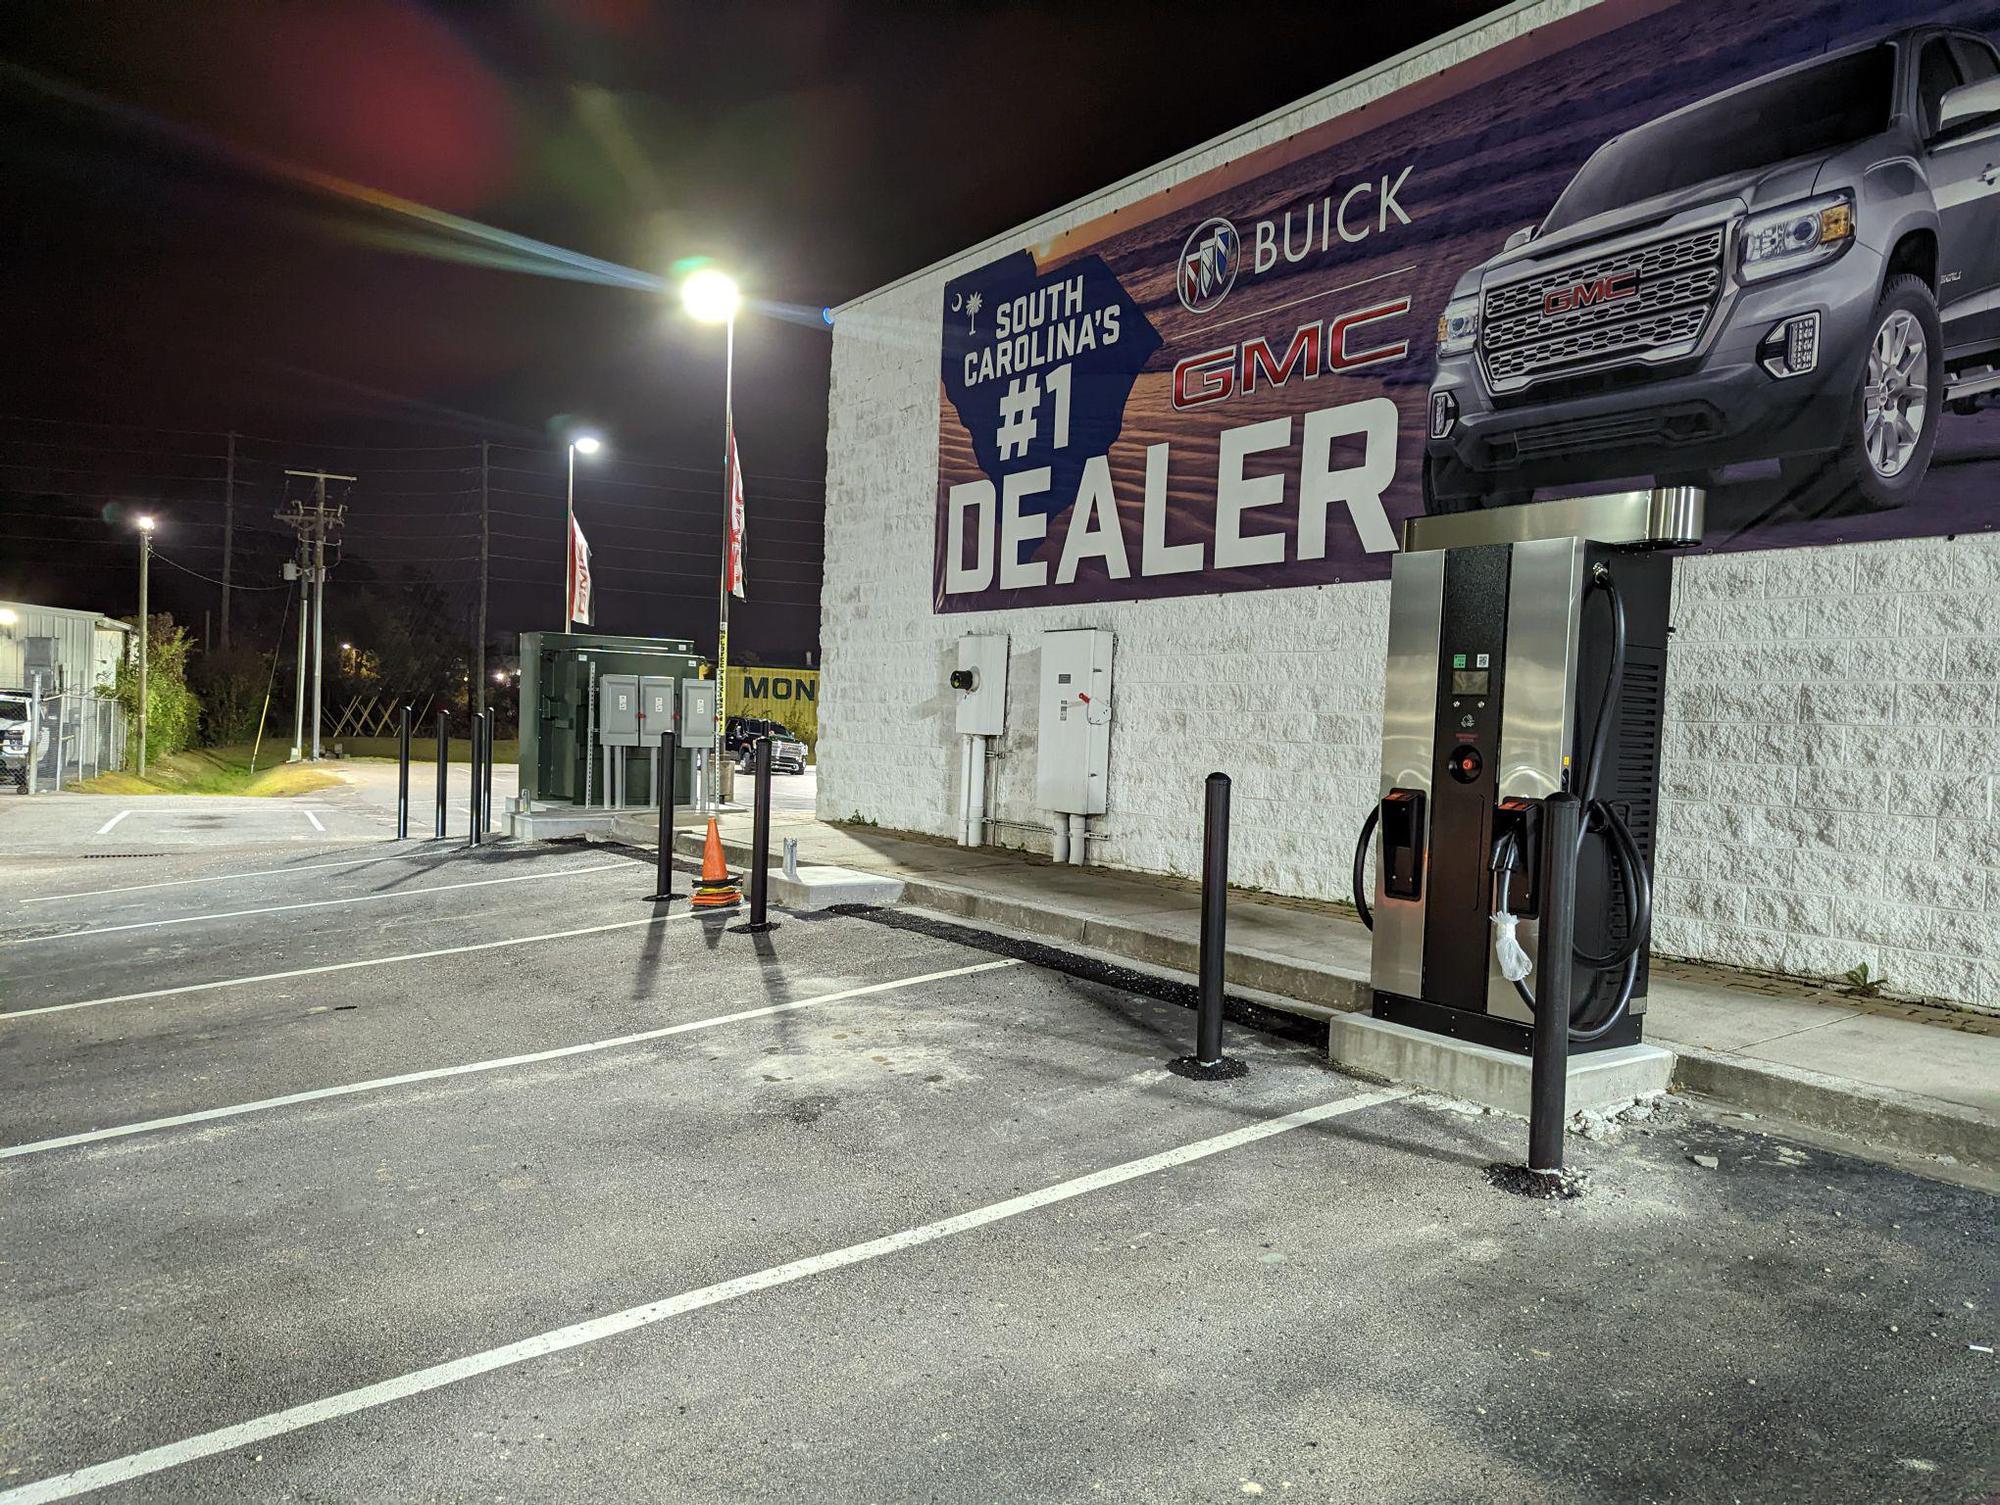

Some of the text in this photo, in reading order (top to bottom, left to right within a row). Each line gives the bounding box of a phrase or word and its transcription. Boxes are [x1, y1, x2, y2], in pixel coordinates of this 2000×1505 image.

[1254, 165, 1415, 274] BUICK
[995, 275, 1084, 340] SOUTH
[1543, 271, 1636, 316] GMC
[963, 304, 1121, 387] CAROLINA'S
[1171, 295, 1412, 411] GMC
[996, 363, 1073, 462] #1
[945, 397, 1400, 595] DEALER
[743, 676, 816, 701] MON
